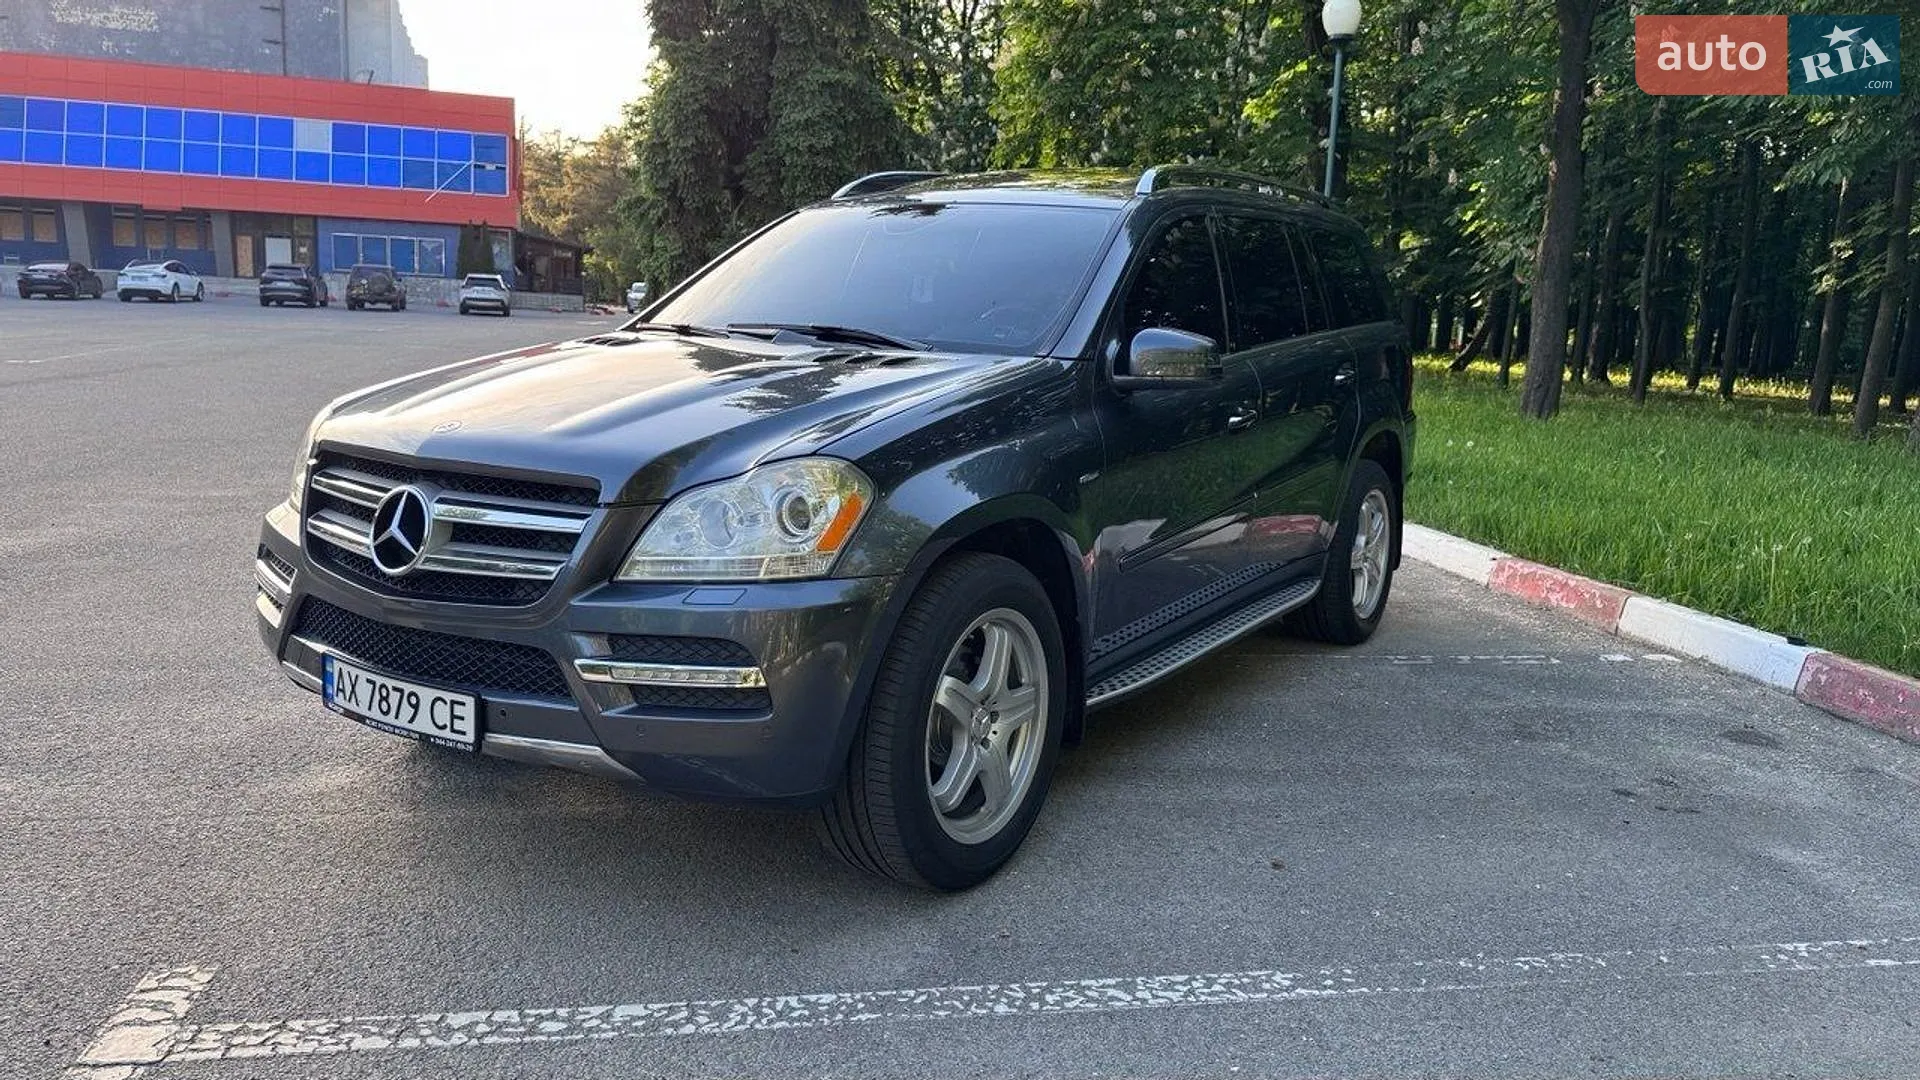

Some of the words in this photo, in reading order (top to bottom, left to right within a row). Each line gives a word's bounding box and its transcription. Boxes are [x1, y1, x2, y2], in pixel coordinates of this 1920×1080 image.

[336, 667, 361, 707] AX
[366, 678, 420, 724] 7879
[430, 696, 467, 736] CE
